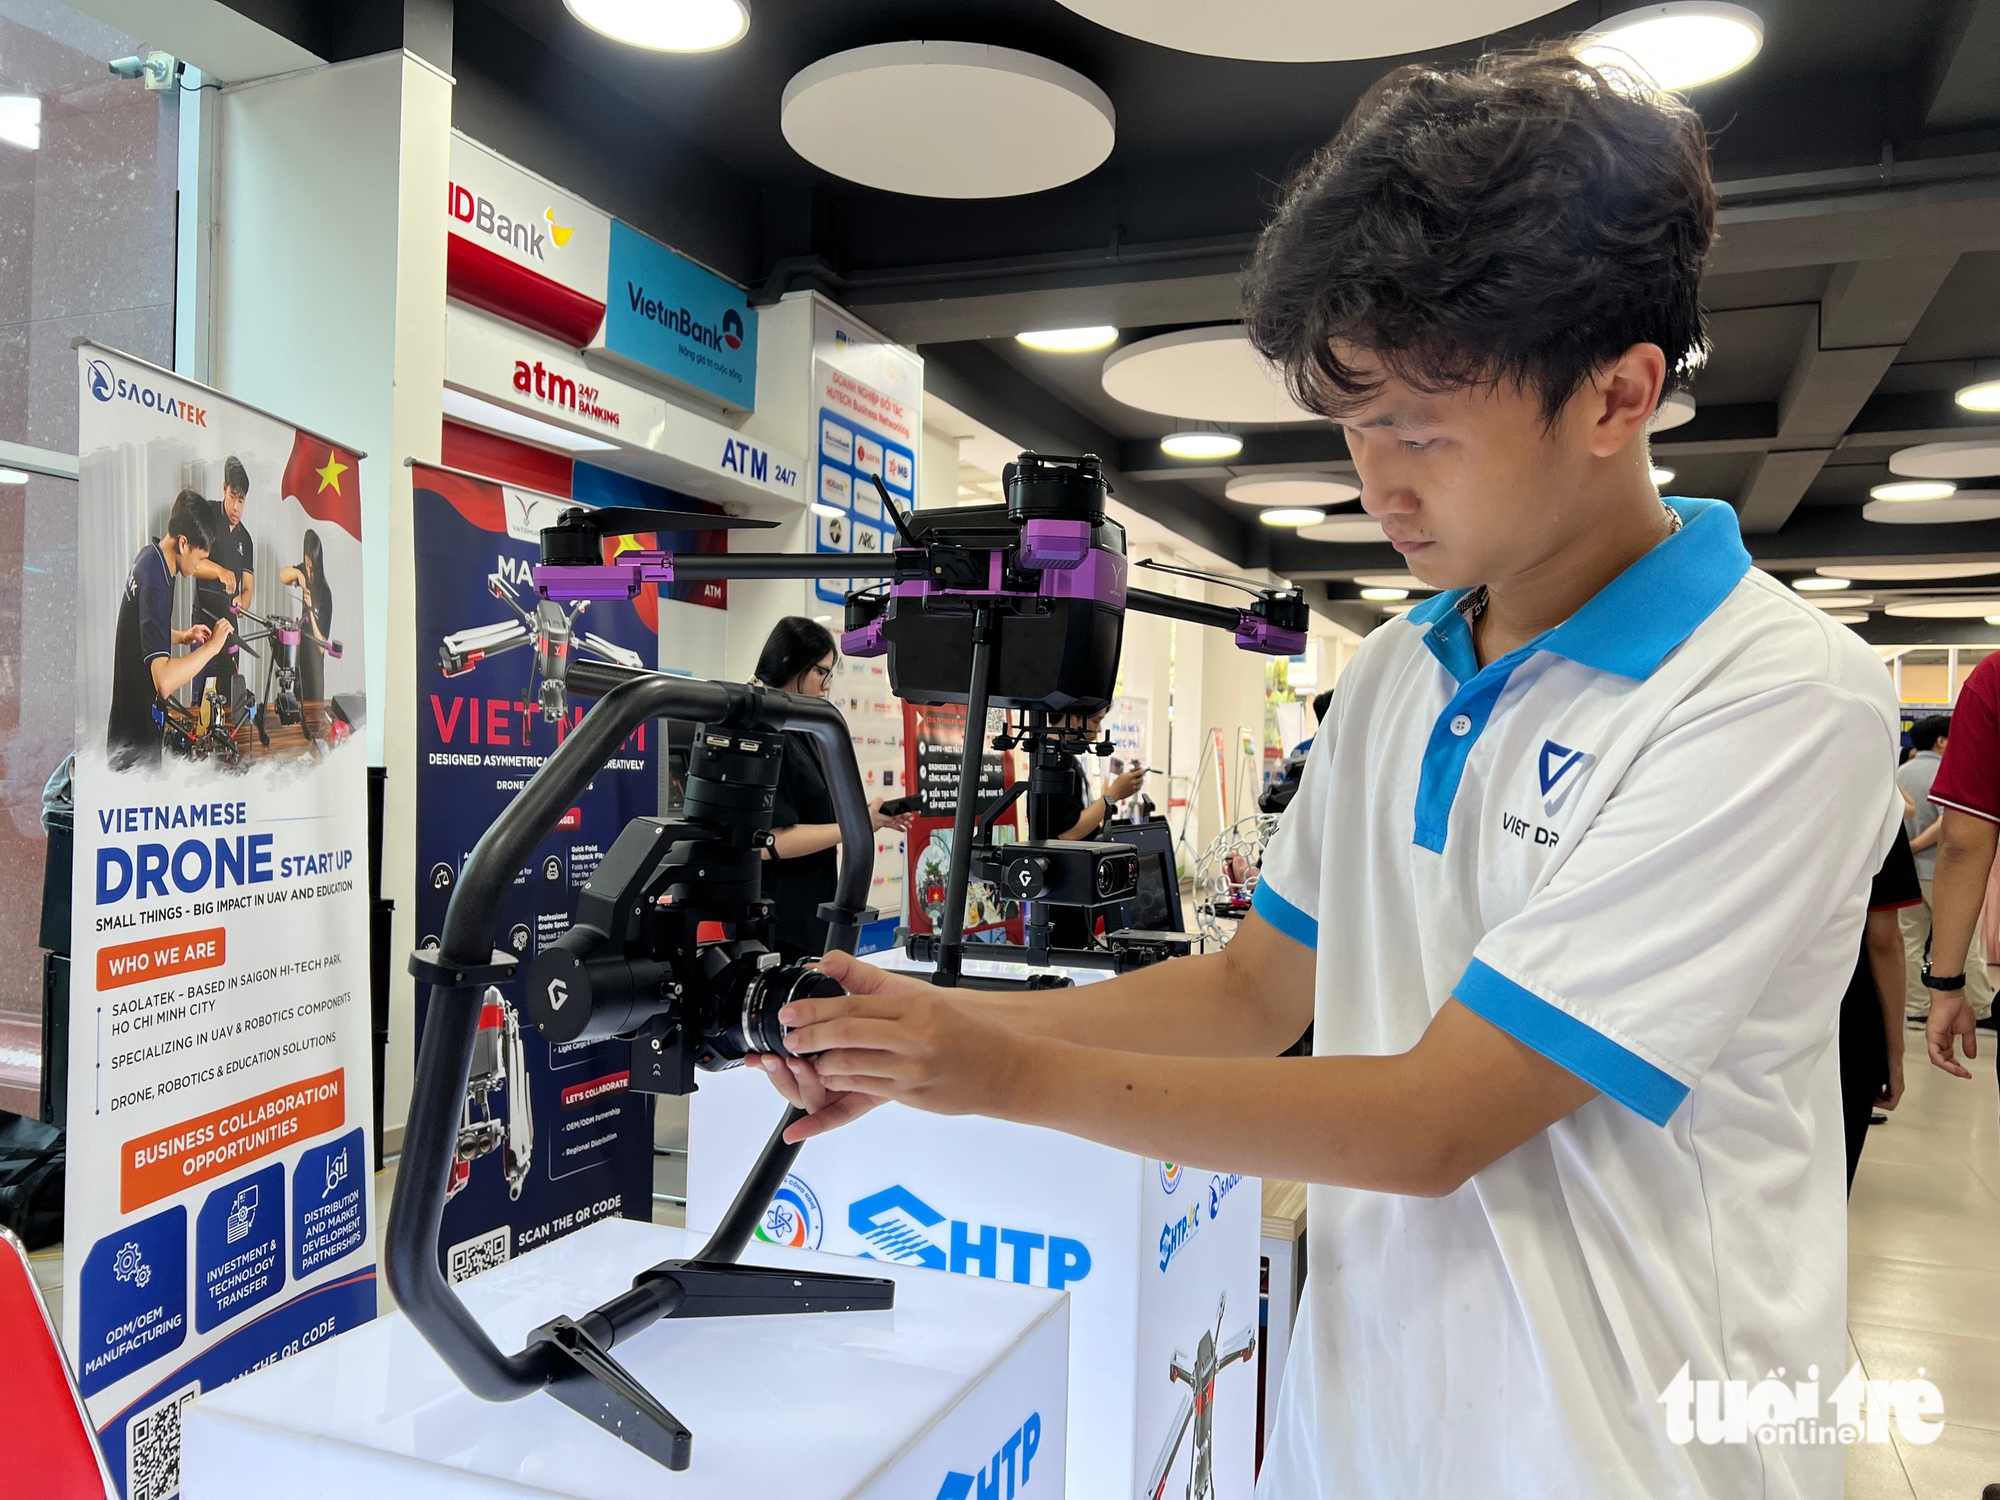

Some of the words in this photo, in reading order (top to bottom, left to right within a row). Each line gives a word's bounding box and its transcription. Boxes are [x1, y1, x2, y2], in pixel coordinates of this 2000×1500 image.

[627, 280, 723, 353] VietinBank
[117, 378, 208, 428] SAOLATEK
[513, 360, 576, 409] atm
[578, 384, 599, 400] 24/7
[578, 401, 620, 425] BANKING
[721, 438, 768, 482] ATM
[774, 465, 797, 487] 24/7
[704, 583, 722, 598] ATM
[430, 694, 541, 746] VIET
[429, 753, 481, 766] DESIGNED
[98, 801, 246, 834] VIETNAMESE
[1503, 811, 1530, 840] VIET
[96, 832, 274, 905] DRONE
[280, 852, 333, 879] START
[336, 849, 353, 871] UP
[96, 913, 136, 932] SMALL
[139, 906, 183, 925] THINGS
[193, 901, 214, 916] BIG
[216, 895, 252, 913] IMPACT
[254, 893, 264, 906] IN
[267, 890, 288, 904] UAV
[290, 887, 314, 901] AND
[317, 880, 353, 897] EDUCATION
[109, 953, 149, 977] WHO
[154, 946, 180, 967] WE
[184, 940, 216, 961] ARE
[112, 991, 175, 1017] SAOLATEK
[187, 980, 225, 998] BASED
[228, 976, 238, 989] IN
[240, 967, 277, 986] SAIGON
[280, 959, 321, 976] HI-TECH
[111, 1036, 193, 1069] SPECIALIZING
[196, 1032, 208, 1045] IN
[211, 1025, 233, 1041] UAV
[235, 1022, 242, 1034] &
[244, 1008, 294, 1031] ROBOTICS
[297, 991, 351, 1016] COMPONENTS
[112, 1020, 130, 1036] HO
[133, 1015, 152, 1030] CHI
[156, 1006, 185, 1024] MINH
[189, 999, 216, 1015] CITY
[111, 1086, 155, 1111] DRONE,
[157, 1068, 214, 1096] ROBOTICS
[217, 1065, 224, 1077] &
[226, 1047, 281, 1075] EDUCATION
[283, 1031, 337, 1056] SOLUTIONS
[565, 1090, 584, 1105] LET'S
[585, 1078, 628, 1099] COLLABORATE
[134, 1124, 214, 1169] BUSINESS
[219, 1080, 338, 1137] COLLABORATION
[182, 1117, 298, 1176] OPPORTUNITIES
[566, 1141, 590, 1156] Regional
[304, 1189, 359, 1225] DISTRIBUTION
[305, 1221, 326, 1239] AND
[328, 1203, 358, 1229] MARKET
[518, 1223, 550, 1246] SCAN
[552, 1213, 574, 1232] THE
[575, 1207, 590, 1223] QR
[592, 1194, 622, 1215] CODE
[302, 1216, 361, 1255] DEVELOPMENT
[302, 1230, 361, 1270] PARTNERSHIPS
[206, 1242, 268, 1283] INVESTMENT
[270, 1239, 277, 1251] &
[208, 1255, 275, 1298] TECHNOLOGY
[216, 1275, 268, 1311] TRANSFER
[85, 1314, 182, 1376] MANUFACTURING
[105, 1306, 163, 1345] ODM/OEM
[281, 1339, 299, 1360] QR
[302, 1316, 336, 1347] CODE
